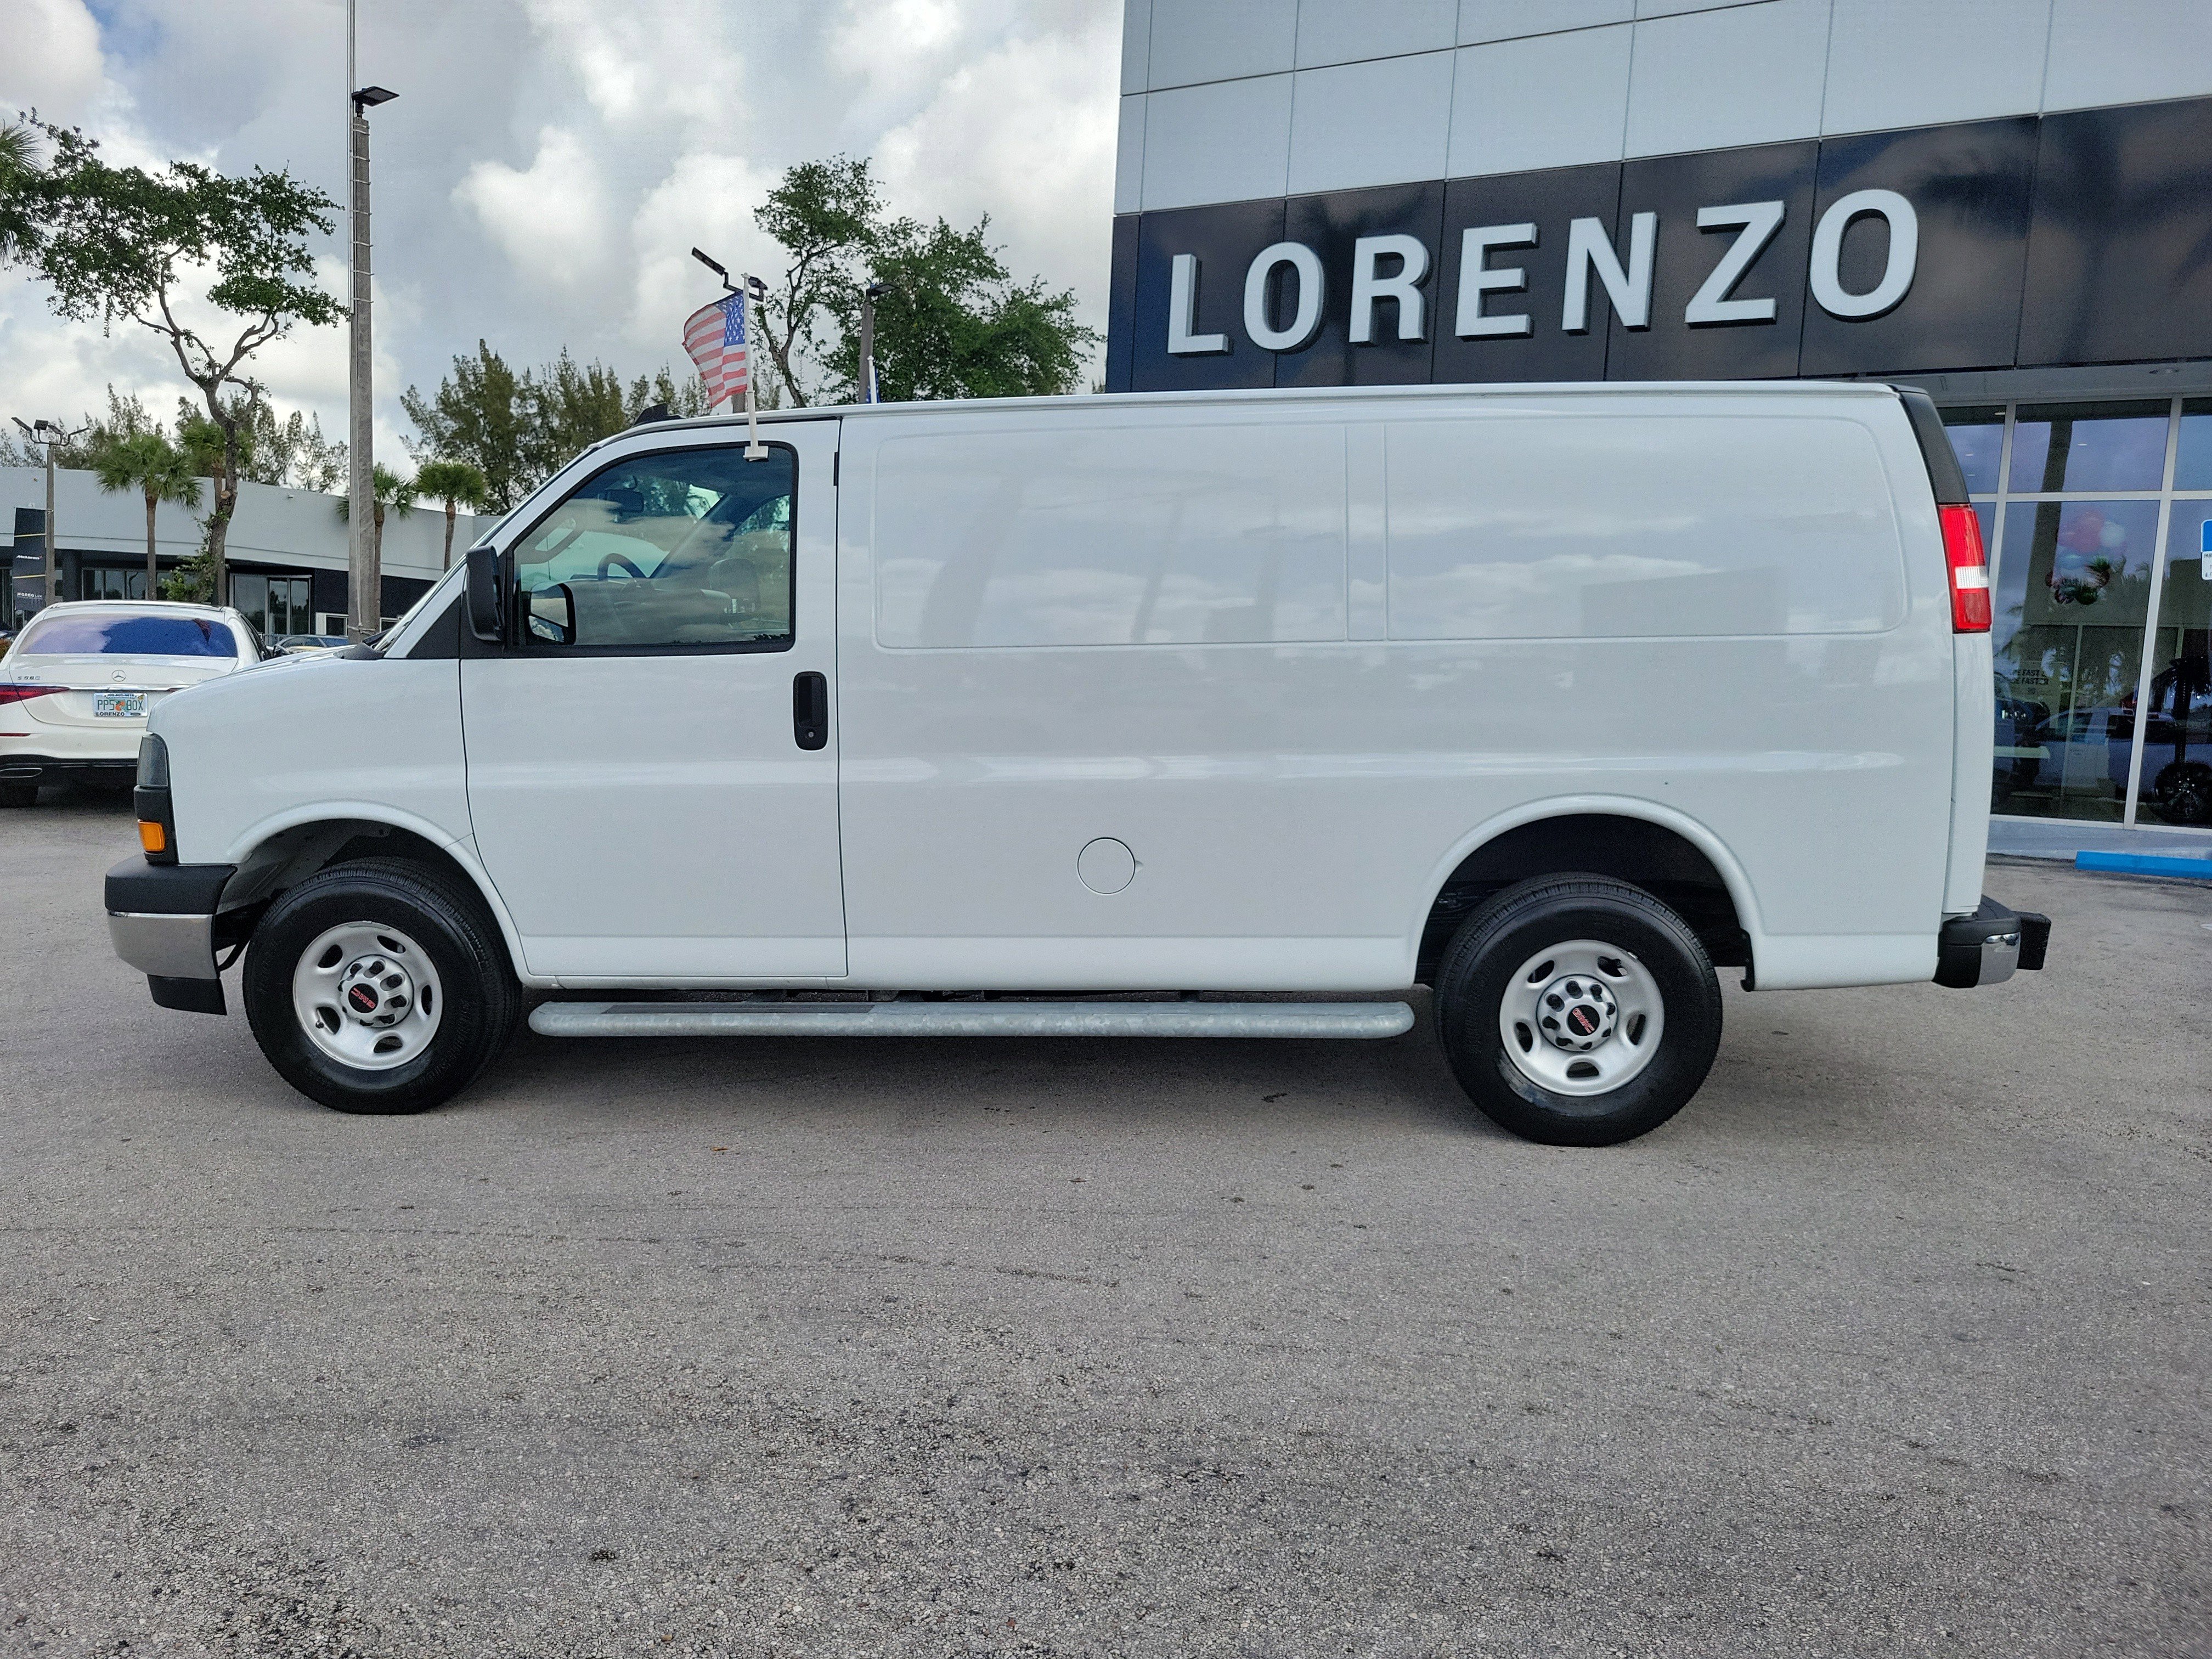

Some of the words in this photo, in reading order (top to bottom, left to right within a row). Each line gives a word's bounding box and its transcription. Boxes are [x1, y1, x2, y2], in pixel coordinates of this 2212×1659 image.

[1167, 189, 1920, 357] LORENZO
[351, 987, 376, 1009] GMC
[1572, 1008, 1595, 1034] GMC
